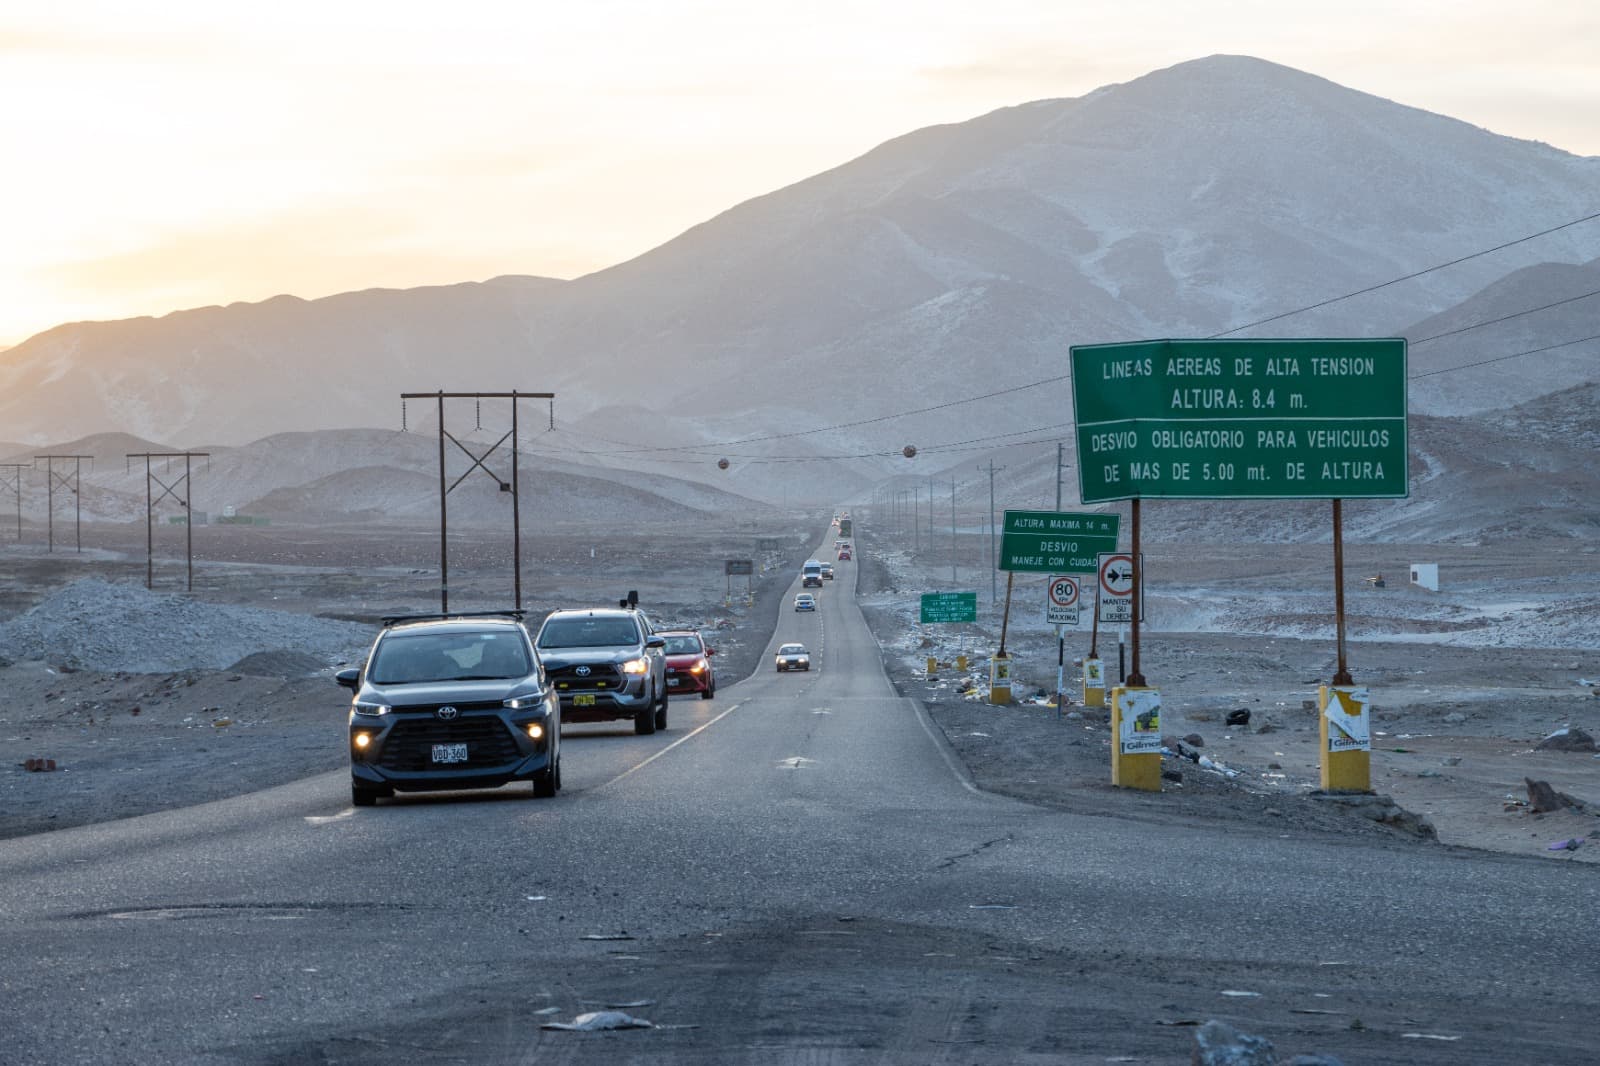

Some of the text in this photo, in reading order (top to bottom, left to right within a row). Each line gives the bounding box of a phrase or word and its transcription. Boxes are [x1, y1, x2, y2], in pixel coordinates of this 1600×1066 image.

[1103, 358, 1374, 380] LINEAS AEREAS DE ALTA TENSION
[1171, 388, 1308, 408] ALTURA: 8.4 m.
[1092, 430, 1389, 452] DESVIO OBLIGATORIO PARA VEHICULOS
[1104, 462, 1385, 483] DE MAS DE 5.00 mt. DE ALTURA
[1014, 519, 1045, 528] ALTURA
[1050, 520, 1080, 528] MAXIMA
[1040, 541, 1078, 552] DESVIO
[1011, 556, 1097, 567] MANEJE CON CUIDAD
[1056, 584, 1073, 595] 80
